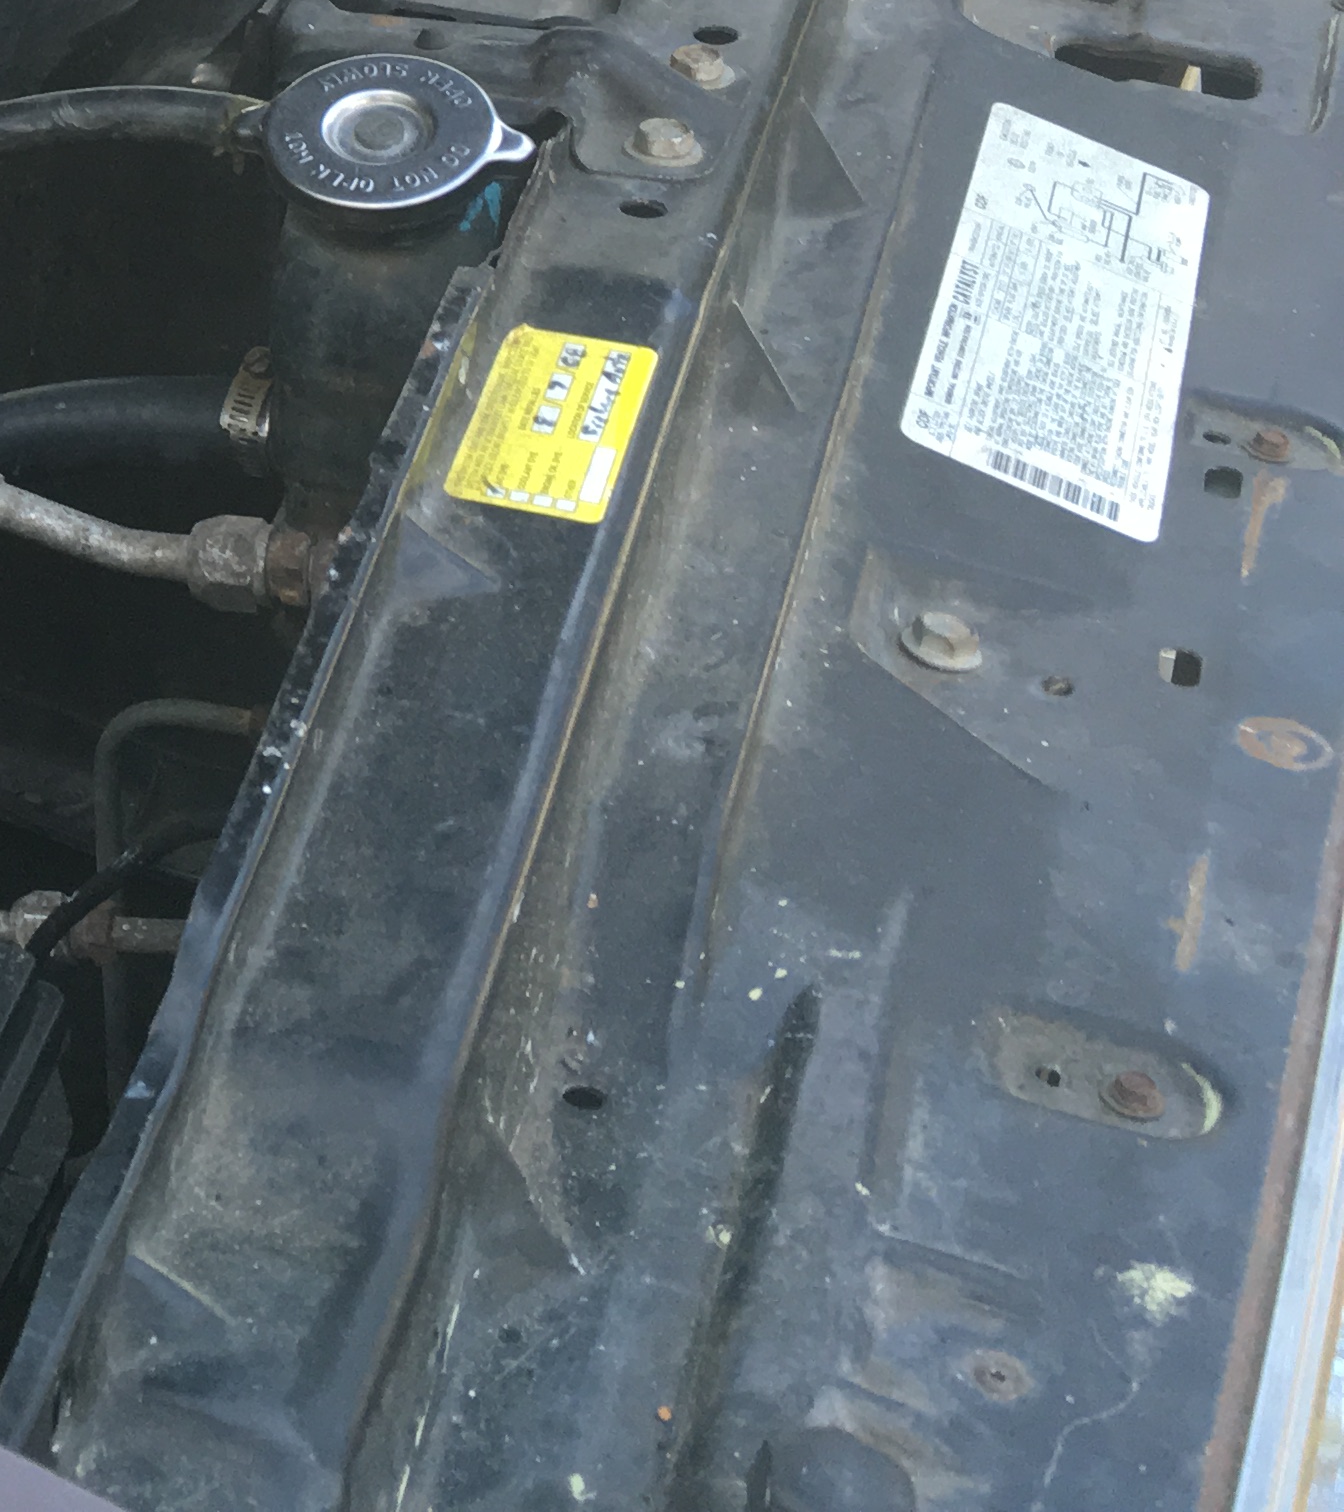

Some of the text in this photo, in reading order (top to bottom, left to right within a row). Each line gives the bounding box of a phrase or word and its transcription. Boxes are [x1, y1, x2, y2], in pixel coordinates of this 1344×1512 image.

[316, 61, 472, 109] OPEN SLOWLY
[441, 144, 471, 169] DO
[392, 166, 439, 192] NOT
[950, 257, 981, 307] CATALYST
